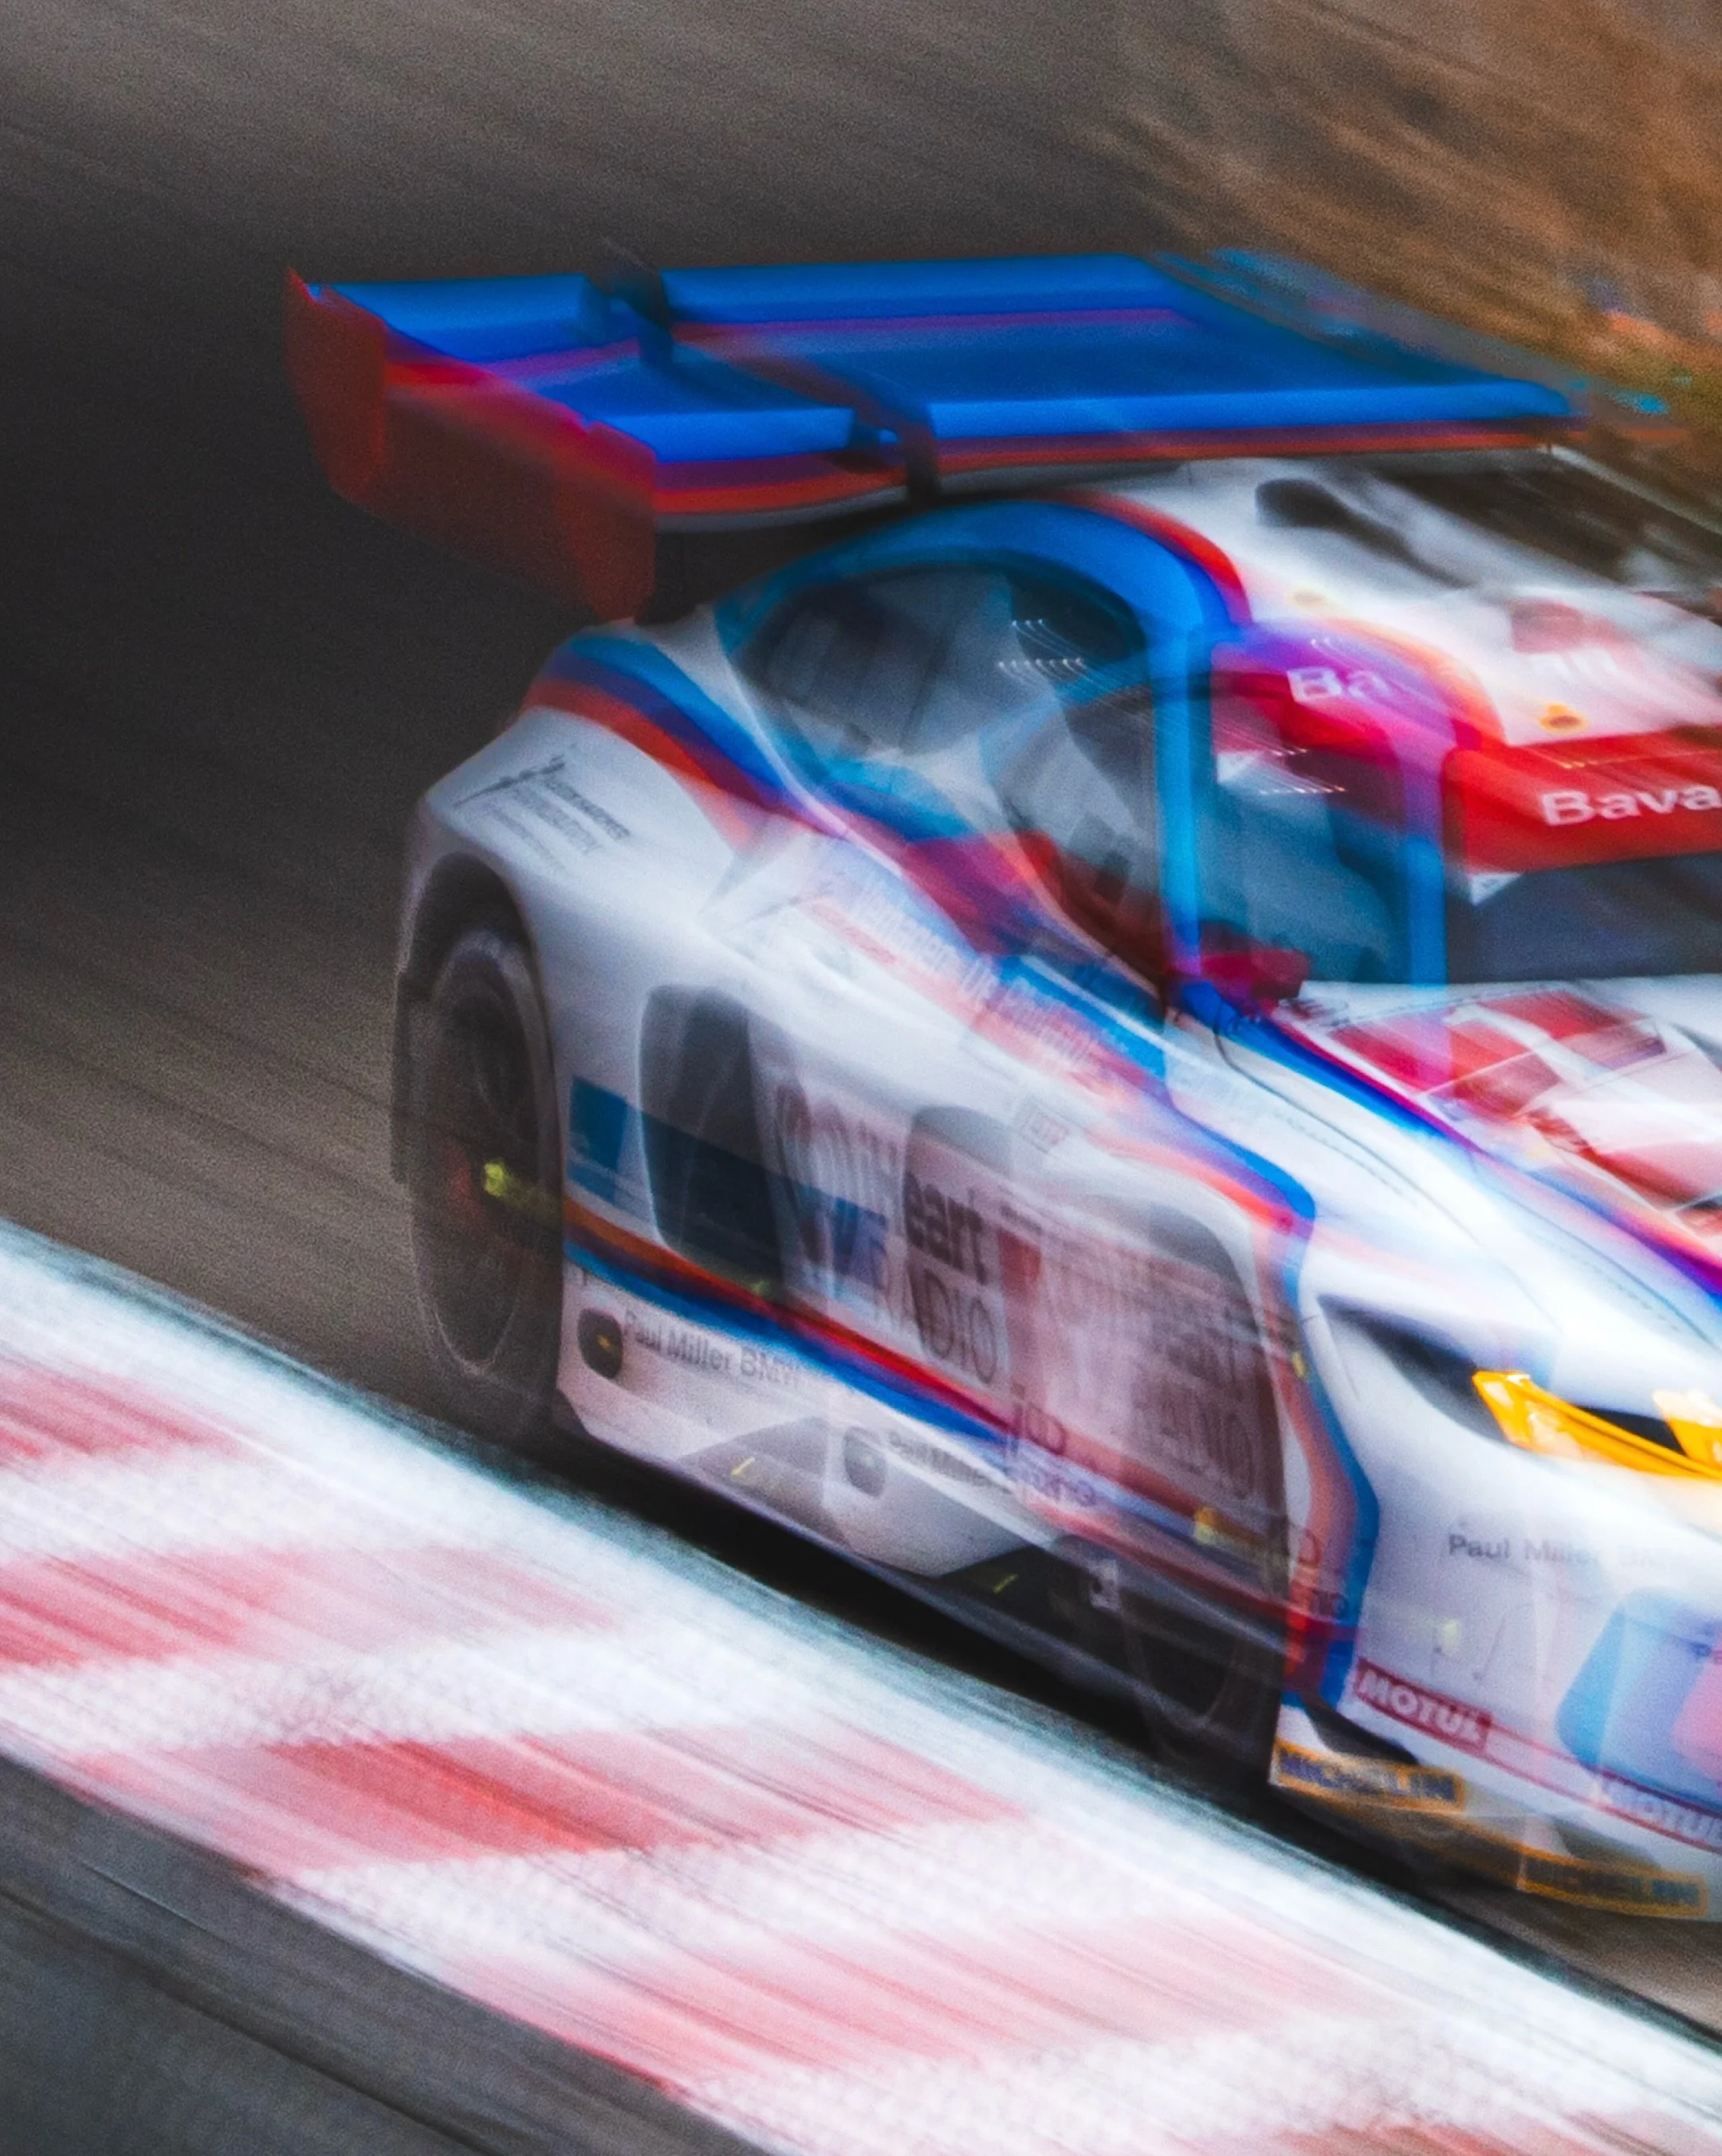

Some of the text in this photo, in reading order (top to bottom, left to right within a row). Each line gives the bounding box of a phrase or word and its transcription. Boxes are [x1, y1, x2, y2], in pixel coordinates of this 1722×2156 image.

[1542, 785, 1722, 826] Bava
[1448, 1533, 1510, 1560] Paul
[1357, 1669, 1483, 1744] MOTUL
